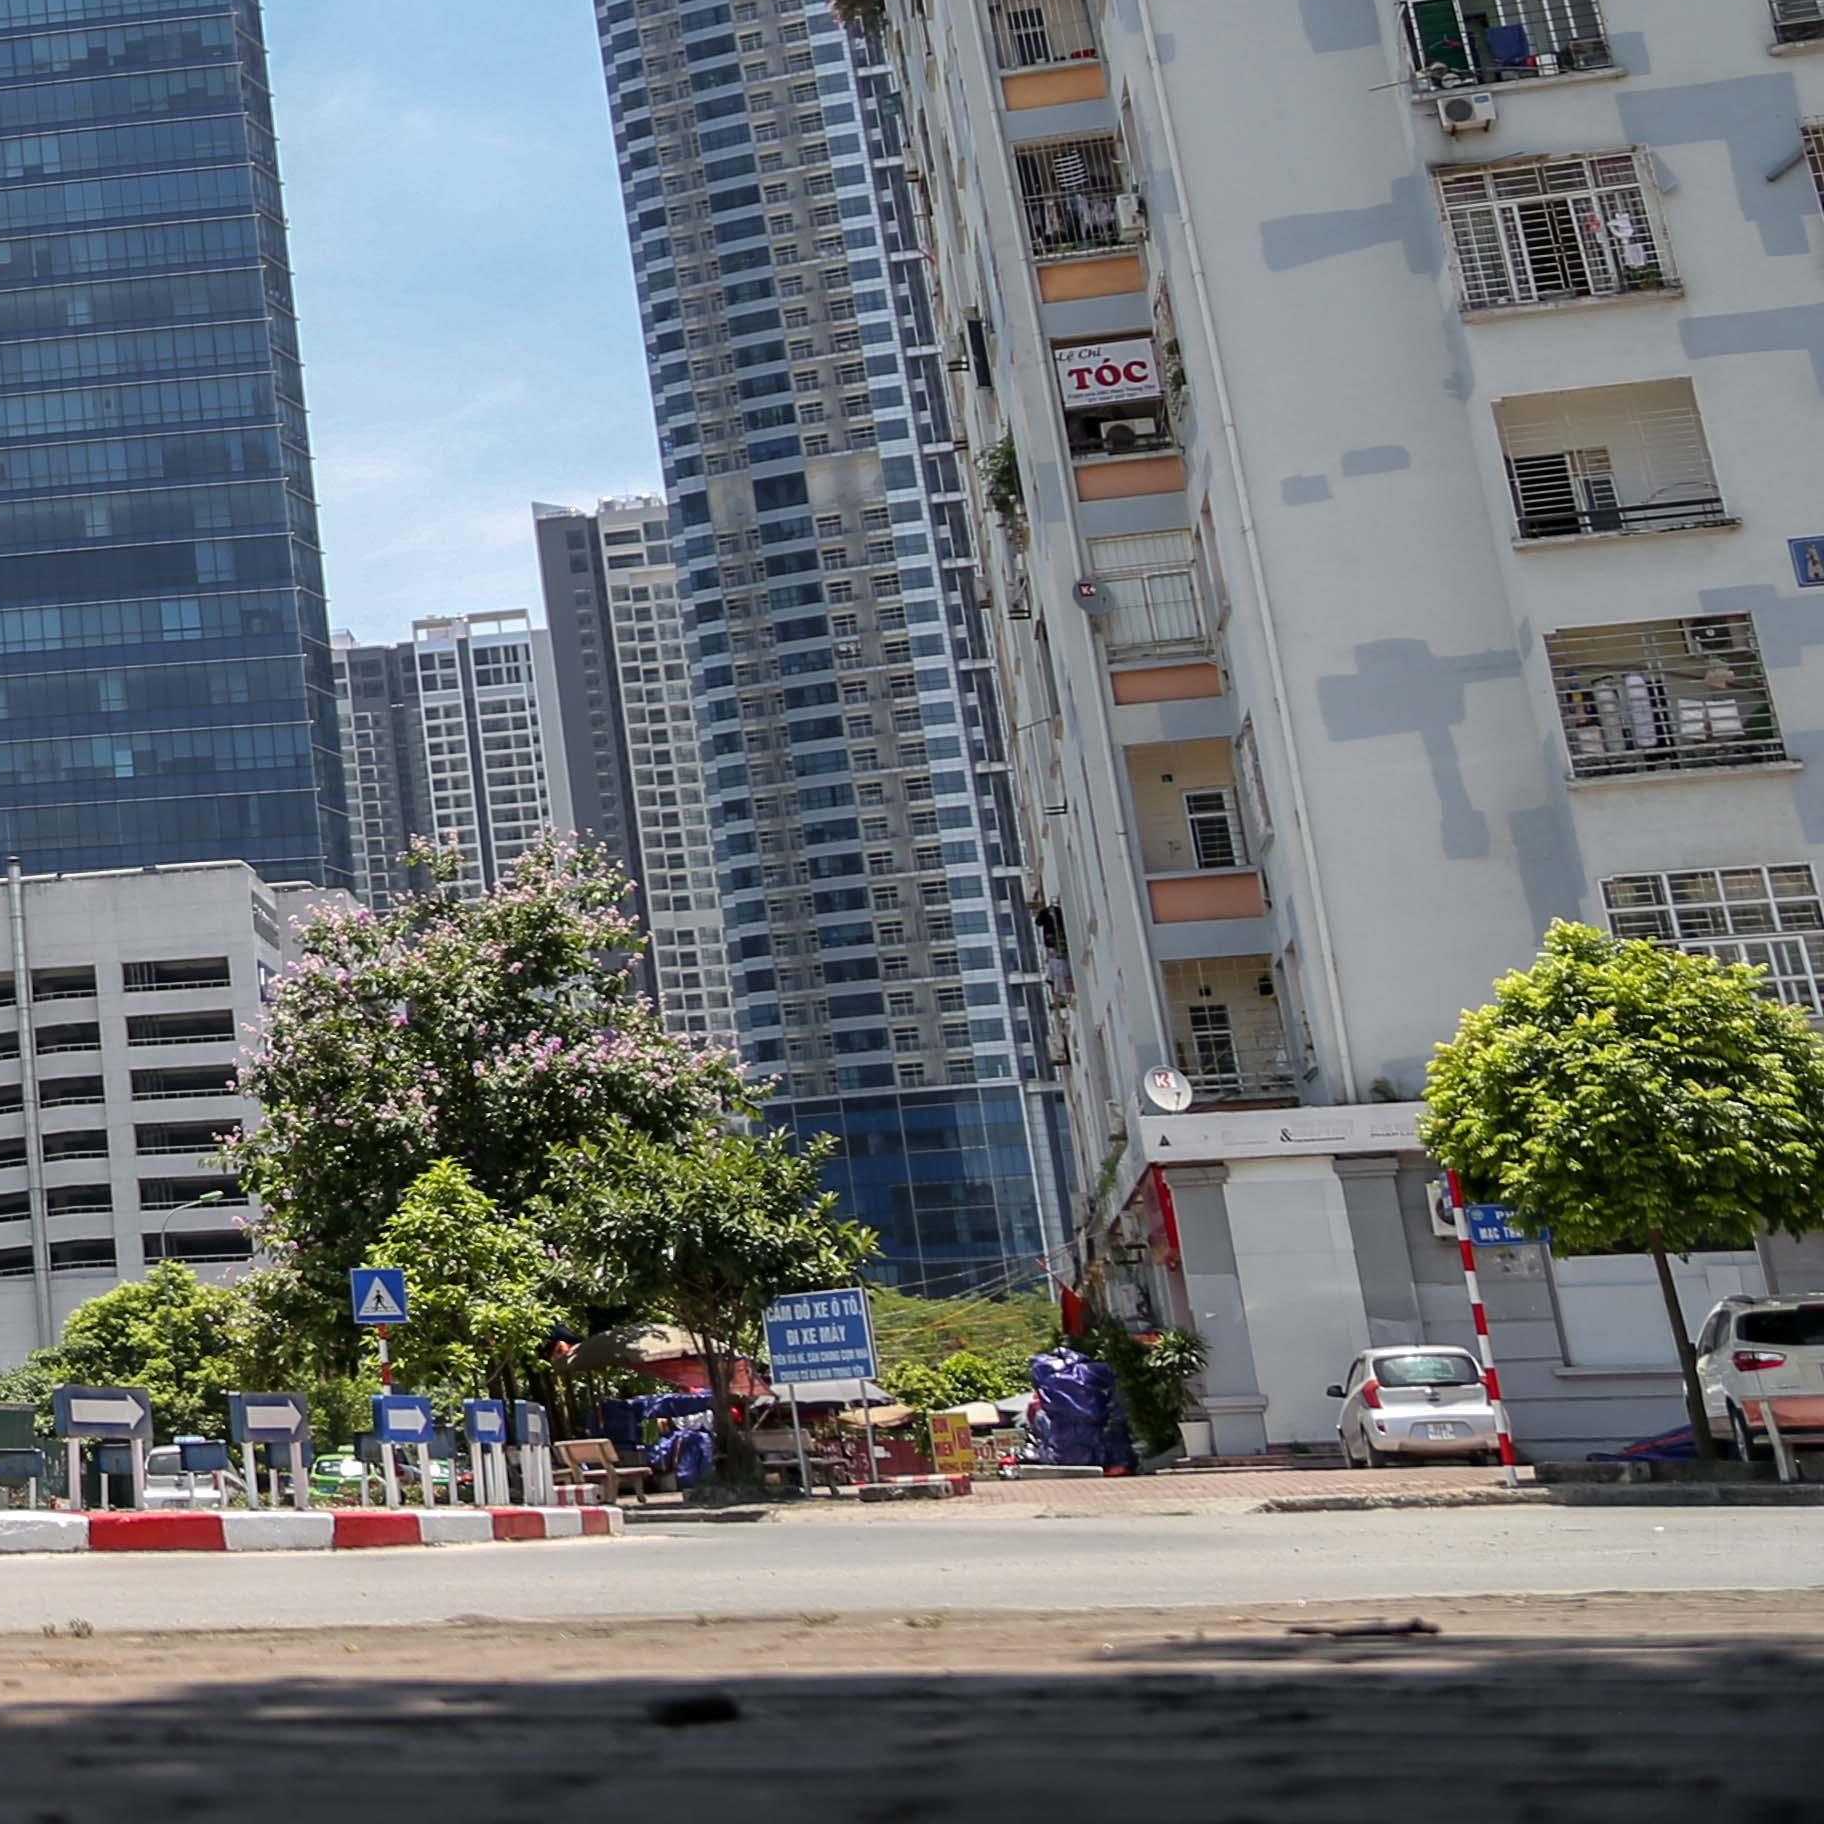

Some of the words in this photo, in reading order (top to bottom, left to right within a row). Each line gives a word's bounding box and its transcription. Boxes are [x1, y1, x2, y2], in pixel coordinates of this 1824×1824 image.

[1067, 357, 1149, 390] TÓC
[766, 1299, 793, 1322] CẤM
[813, 1302, 829, 1319] XE
[830, 1297, 841, 1317] Ô
[800, 1327, 818, 1345] XE
[818, 1322, 847, 1344] MÁY
